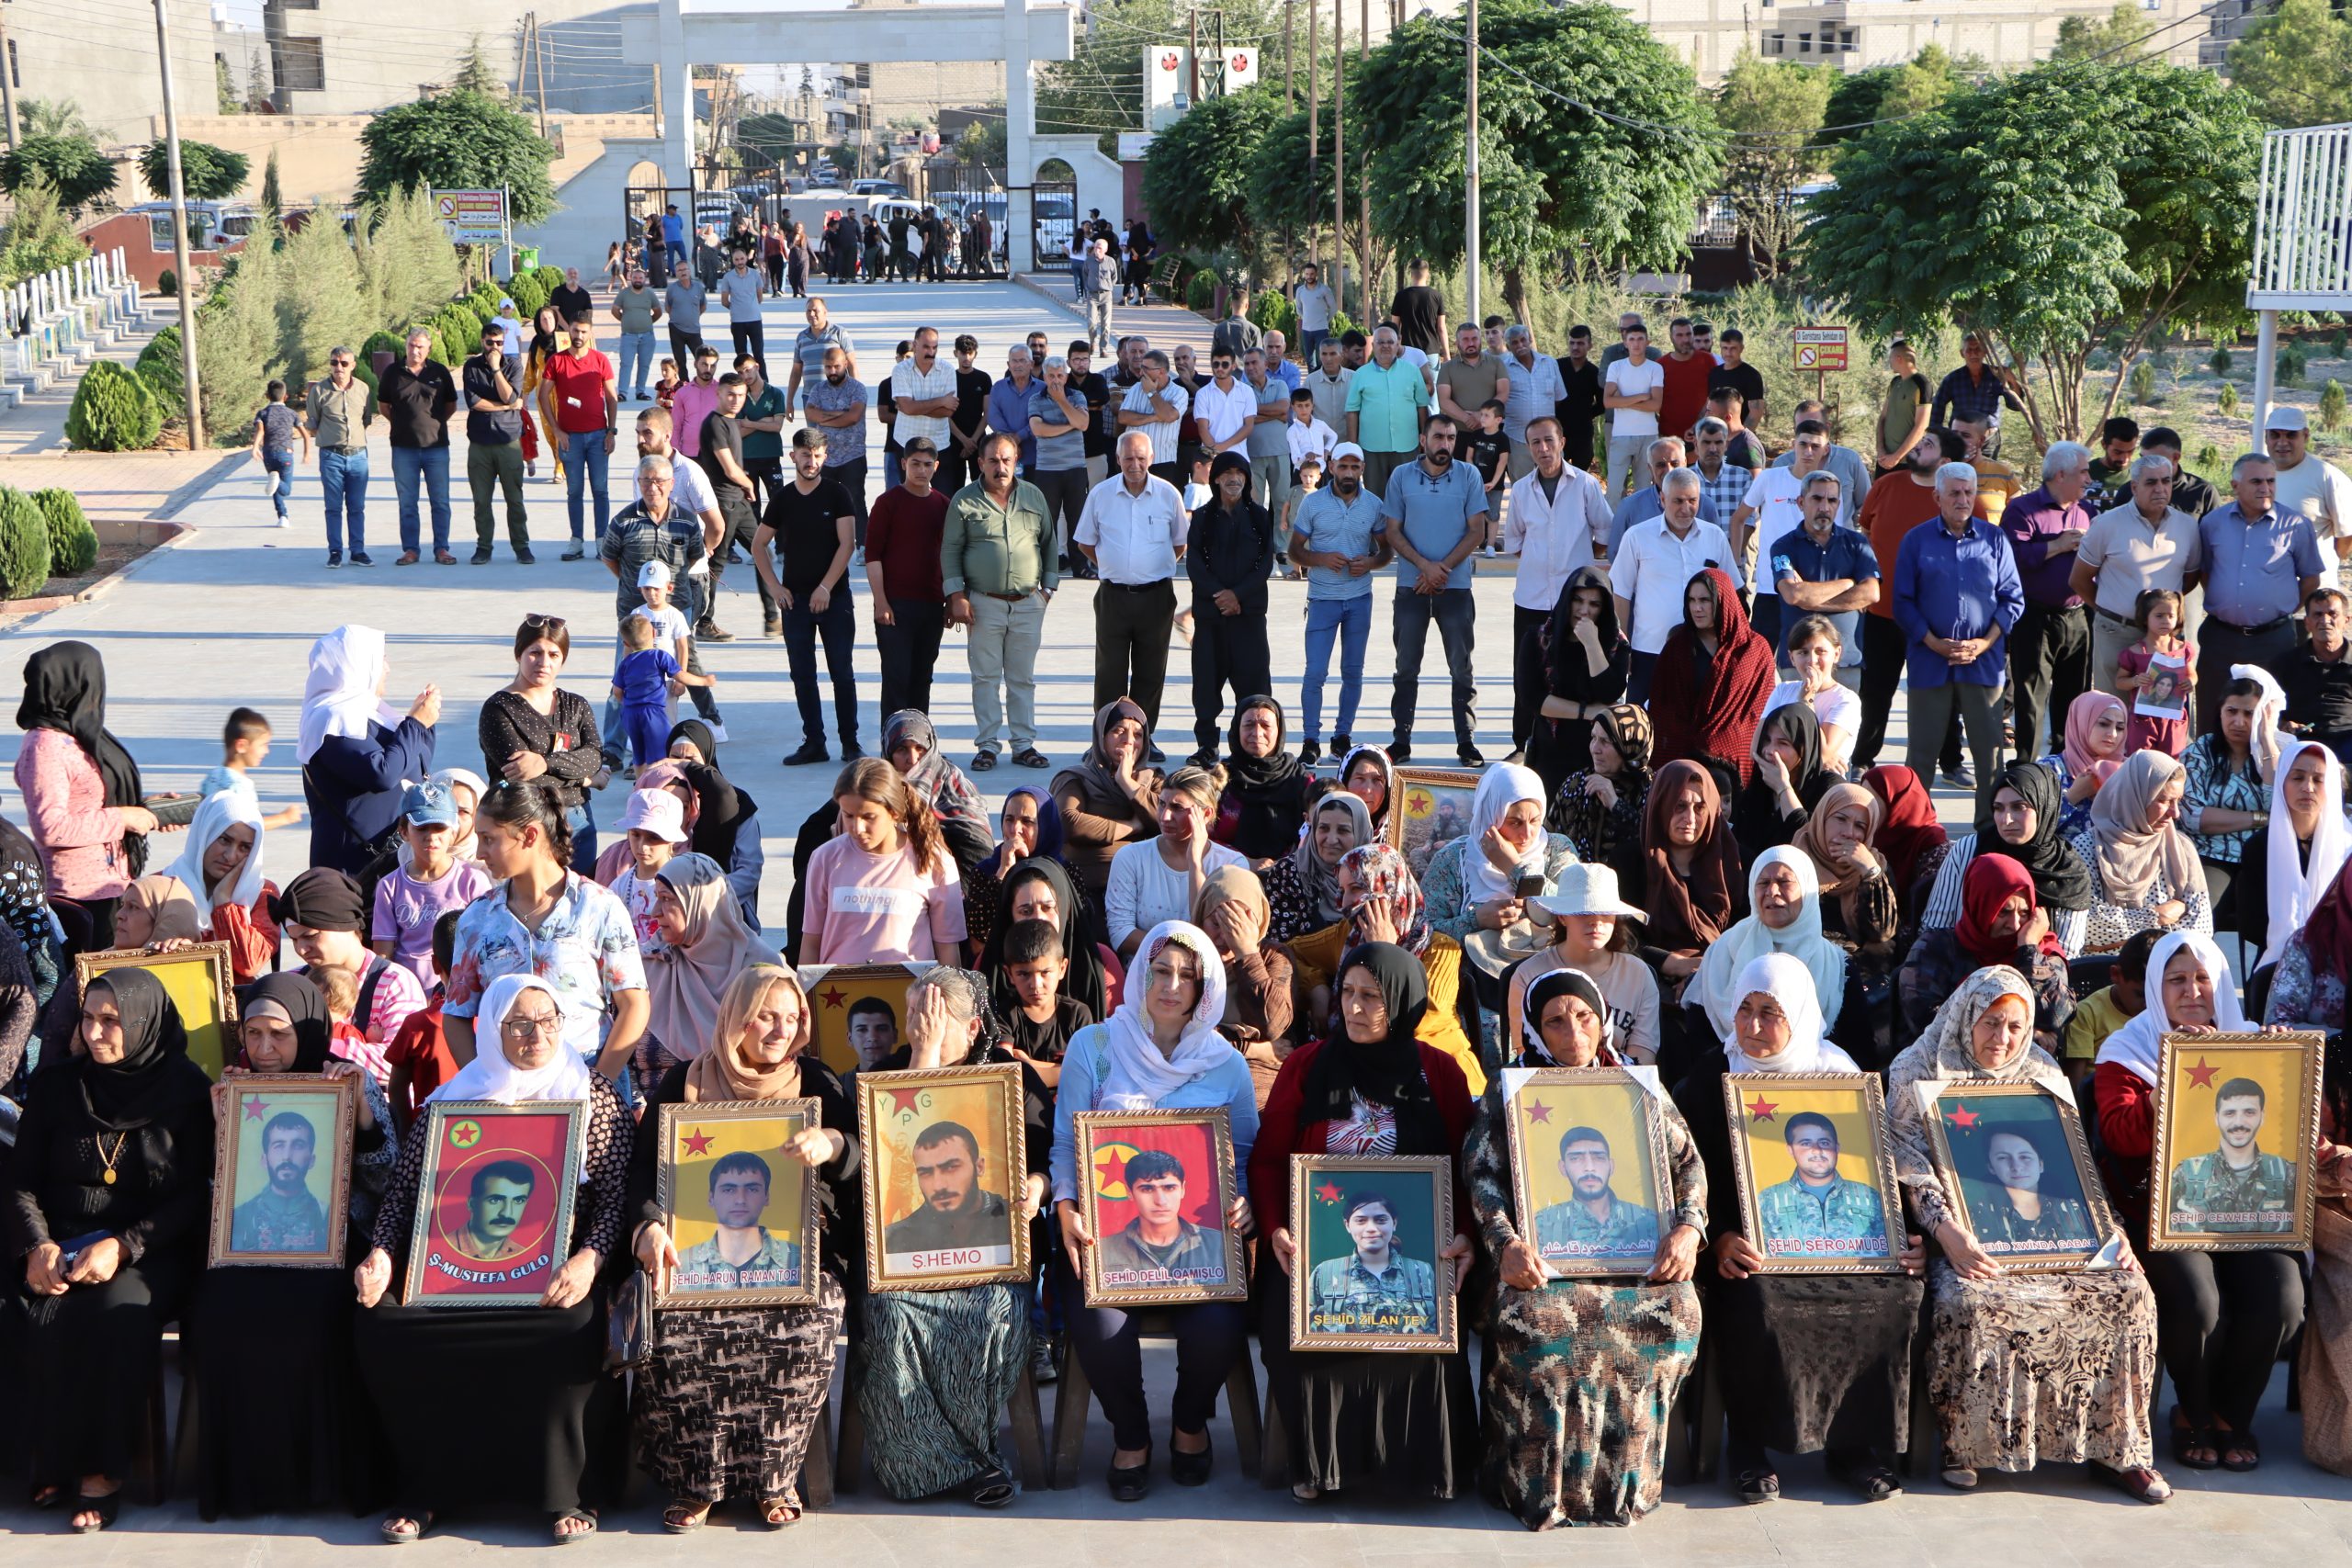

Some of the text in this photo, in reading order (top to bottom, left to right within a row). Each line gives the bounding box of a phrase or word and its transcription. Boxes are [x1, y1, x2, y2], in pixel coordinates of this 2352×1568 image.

[511, 1254, 550, 1280] GULO
[912, 1250, 981, 1269] Ş.HEMO
[702, 1269, 736, 1284] HARÛN
[740, 1269, 776, 1283] RAMAN
[1172, 1268, 1224, 1282] QAMIŞLO
